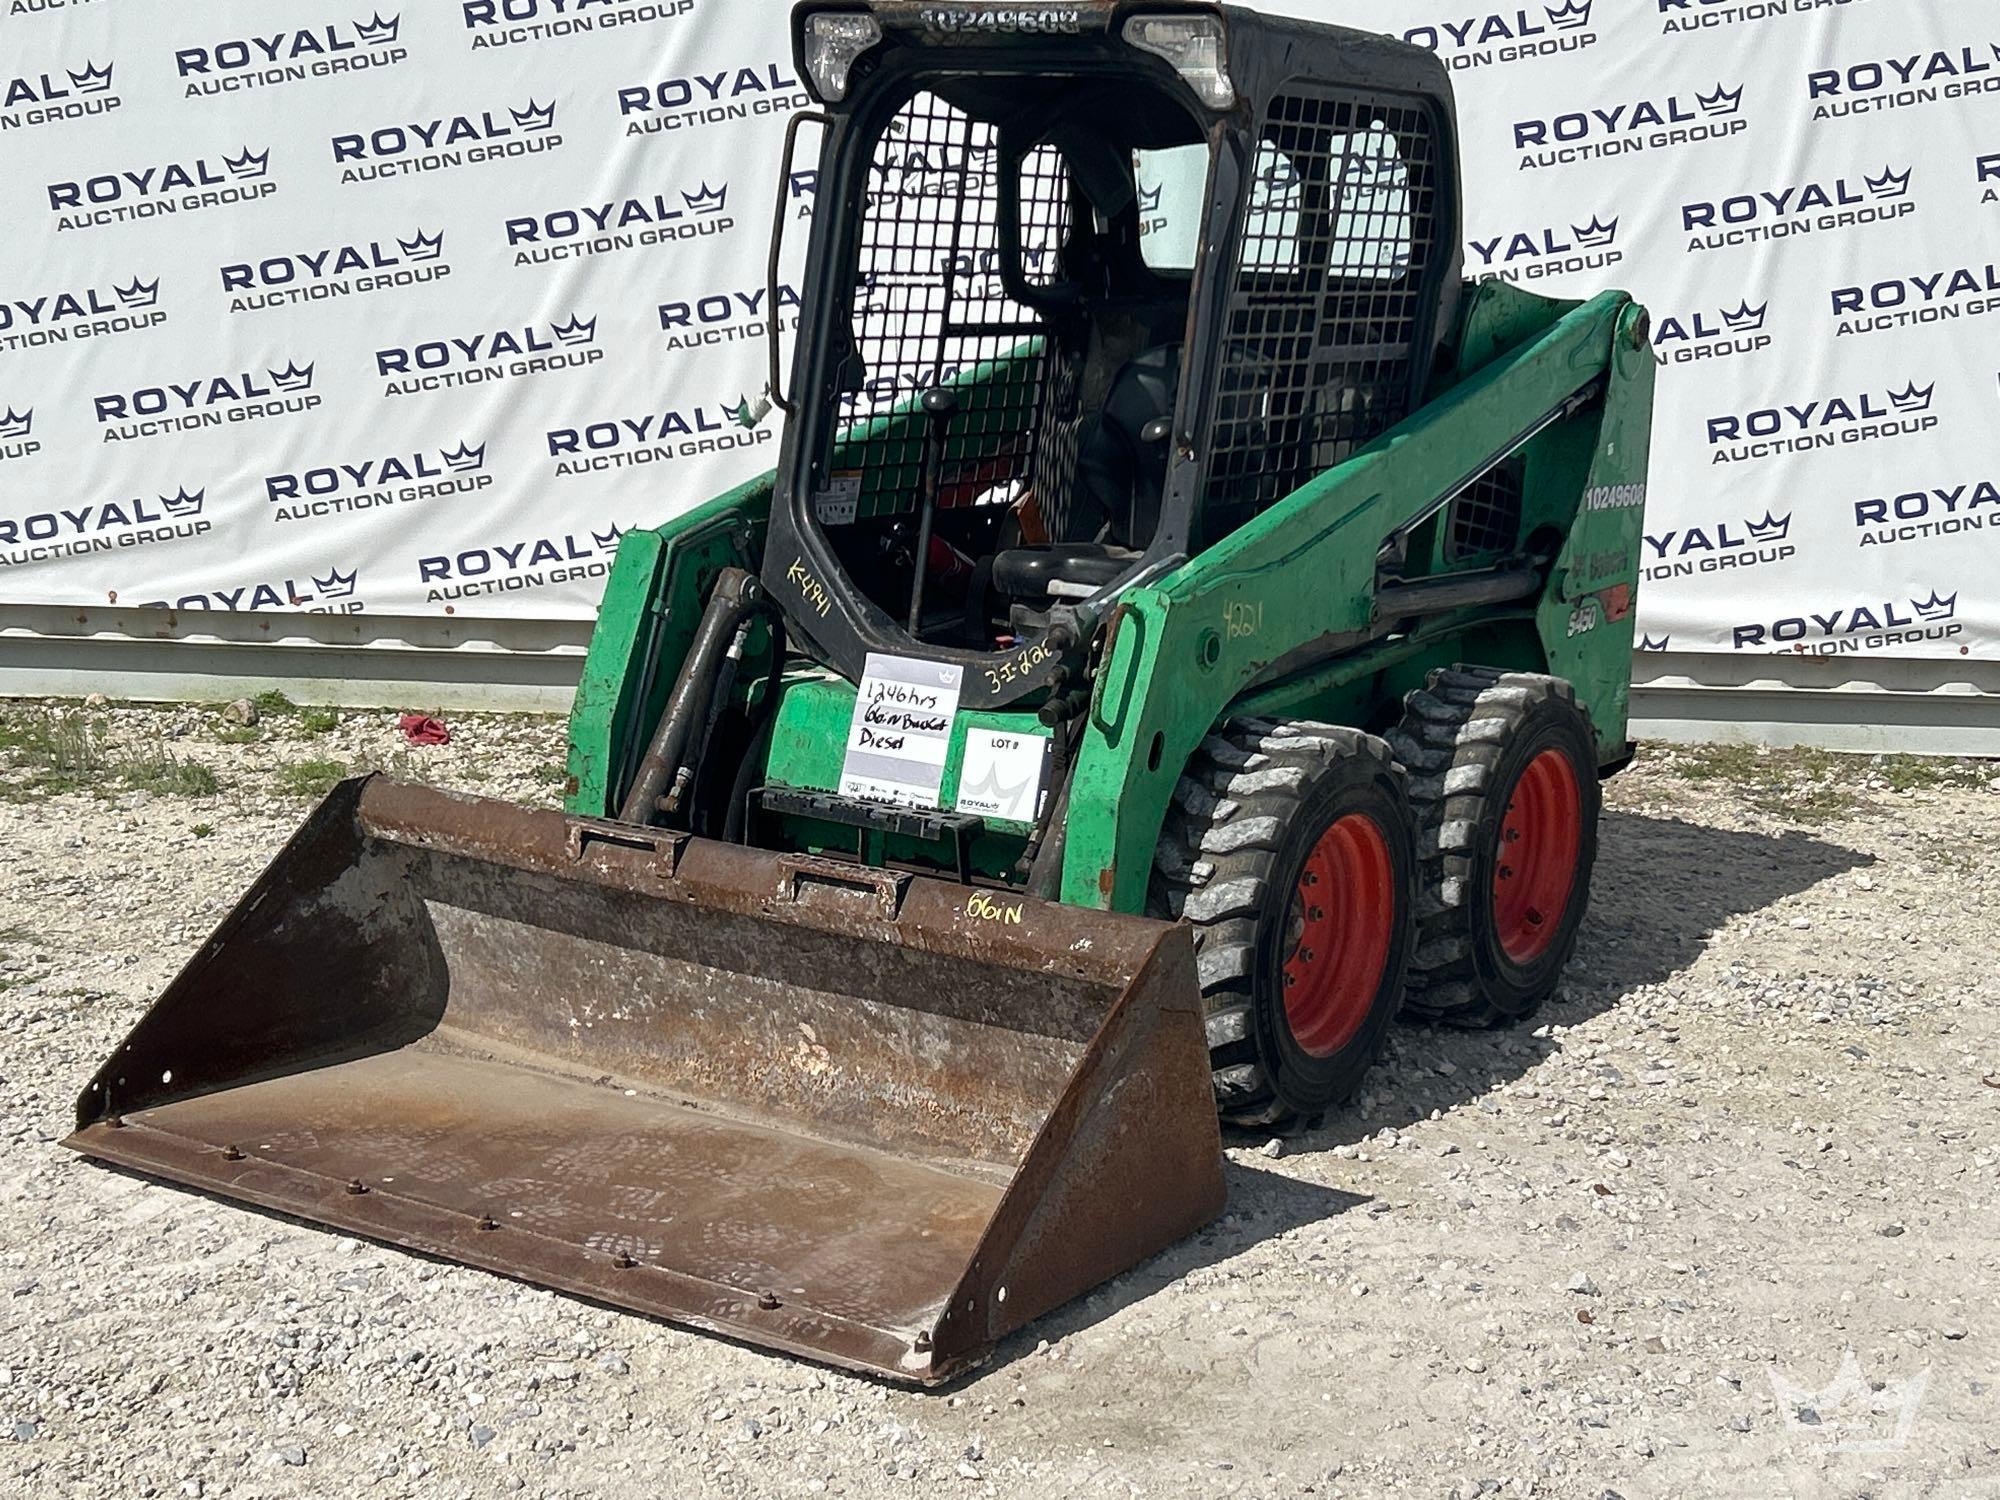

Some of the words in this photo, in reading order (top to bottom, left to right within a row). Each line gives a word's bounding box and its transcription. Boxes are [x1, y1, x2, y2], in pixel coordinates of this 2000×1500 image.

[463, 0, 626, 28] ROY
[472, 17, 592, 50] AUCTION
[599, 0, 694, 28] GROUP
[1403, 10, 1545, 52] OYAL
[1663, 1, 1787, 34] AUCTION
[175, 25, 355, 77] ROYAL
[1500, 33, 1597, 62] GROUP
[185, 65, 305, 98] AUCTION
[312, 48, 407, 76] GROUP
[618, 64, 797, 115] ROYAL
[1808, 47, 1990, 99] ROYAL
[27, 97, 121, 124] GROUP
[627, 103, 746, 136] AUCTION
[753, 93, 810, 115] GRO
[1813, 87, 1936, 120] AUCTION
[1944, 77, 2000, 98] GRO
[332, 112, 511, 163] ROYAL
[1514, 97, 1695, 149] ROYAL
[1520, 137, 1643, 170] AUCTION
[1650, 120, 1747, 148] GROUP
[341, 152, 461, 184] AUCTION
[468, 135, 562, 162] GROUP
[48, 160, 225, 210] ROYAL
[58, 199, 176, 231] AUCTION
[182, 183, 276, 210] GROUP
[1682, 179, 1863, 231] ROYAL
[506, 195, 683, 245] ROYAL
[515, 234, 633, 266] AUCTION
[640, 218, 733, 245] GROUP
[1687, 219, 1810, 252] AUCTION
[1818, 202, 1915, 230] GROUP
[220, 242, 399, 292] ROYAL
[1468, 228, 1571, 265] YAL
[1526, 251, 1622, 279] GROUP
[0, 289, 116, 330] YAL
[230, 281, 350, 313] AUCTION
[356, 265, 450, 292] GROUP
[658, 284, 801, 330] ROYA
[0, 328, 68, 351] TION
[74, 312, 166, 338] GROUP
[1836, 304, 1959, 336] AUCTION
[376, 327, 553, 376] ROYAL
[1674, 335, 1771, 363] GROUP
[385, 365, 503, 397] AUCTION
[510, 349, 603, 376] GROUP
[94, 374, 270, 422] ROYAL
[104, 411, 222, 443] AUCTION
[228, 395, 321, 422] GROUP
[1707, 394, 1887, 444] ROYAL
[547, 408, 722, 456] ROYAL
[556, 446, 673, 476] AUCTION
[679, 430, 772, 456] GROUP
[1712, 432, 1834, 464] AUCTION
[1841, 416, 1937, 443] GROUP
[265, 453, 441, 502] ROYAL
[275, 491, 393, 522] AUCTION
[399, 475, 492, 501] GROUP
[1586, 483, 1646, 511] 10249608
[0, 499, 161, 544] ROYAL
[1855, 482, 2000, 526] ROYA
[0, 537, 112, 566] AUCTION
[118, 521, 211, 547] GROUP
[1642, 523, 1745, 559] YAL
[1860, 516, 1982, 547] AUCTION
[419, 535, 592, 583] ROYAL
[427, 573, 544, 603] AUCTION
[550, 562, 612, 583] GRO
[1699, 545, 1795, 573] GROUP
[1733, 603, 1912, 649] ROYAL
[1865, 624, 1962, 650] GROUP
[991, 738, 1011, 749] LOT
